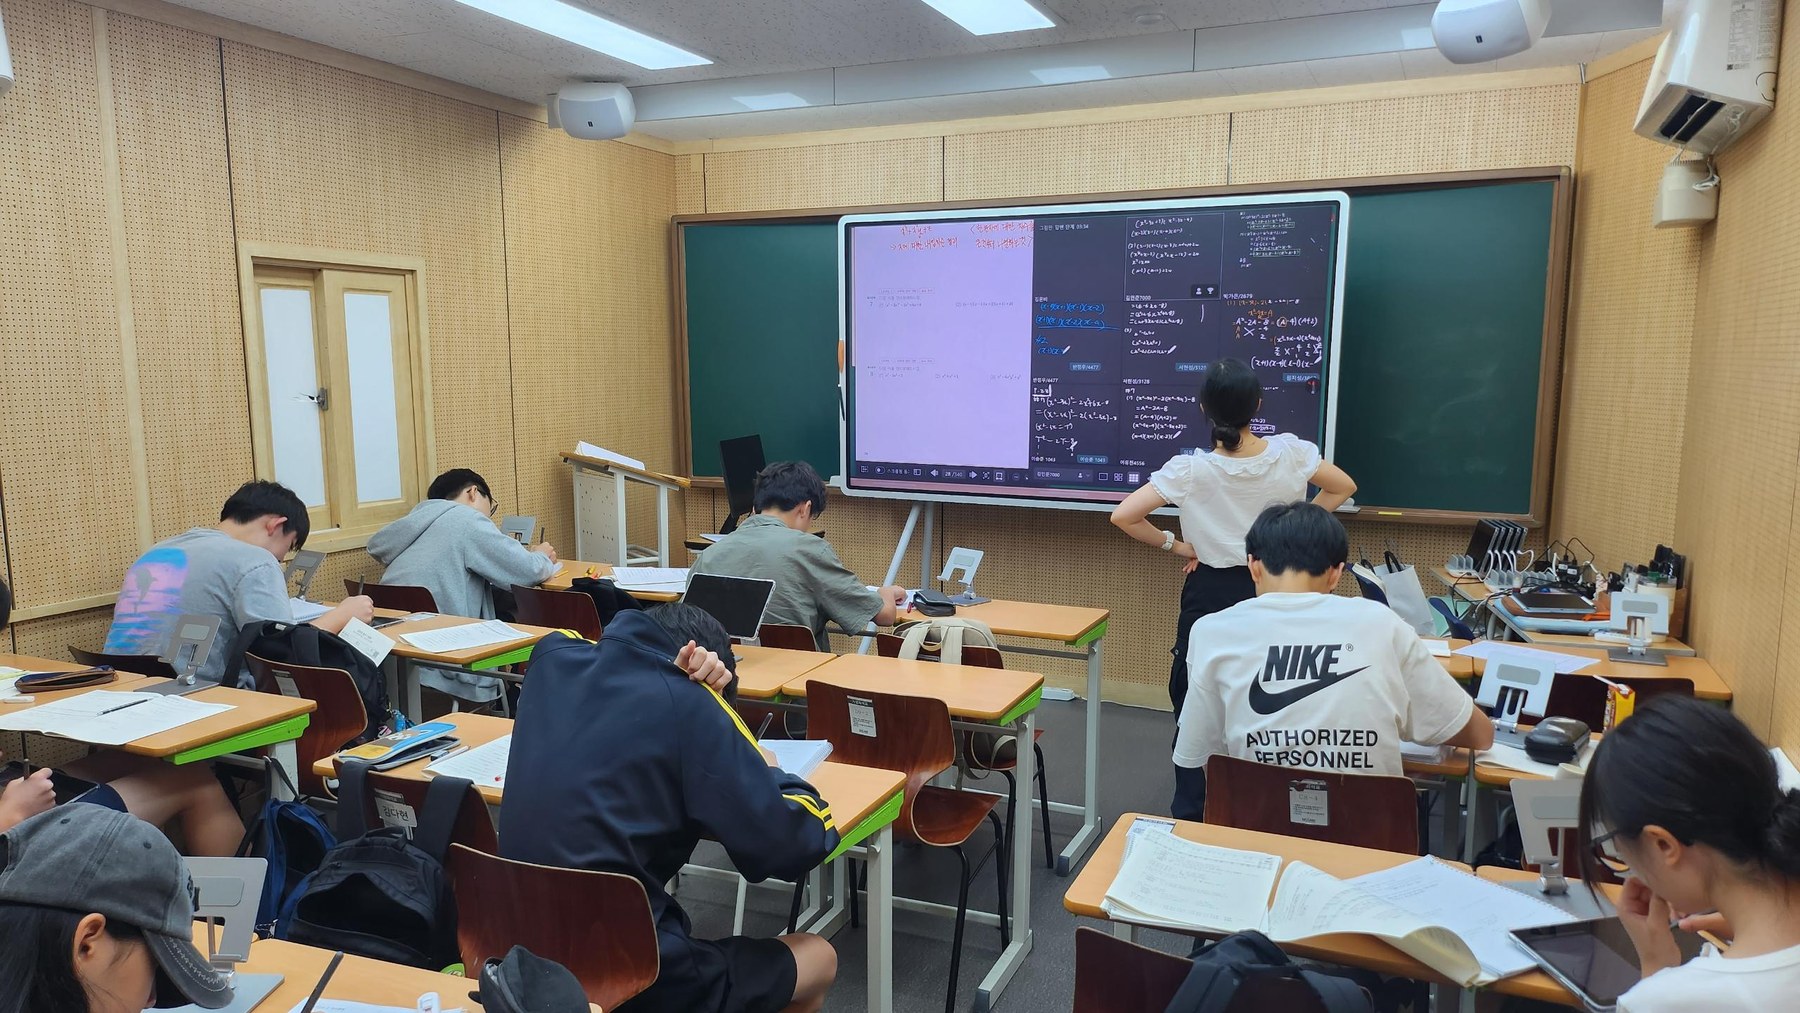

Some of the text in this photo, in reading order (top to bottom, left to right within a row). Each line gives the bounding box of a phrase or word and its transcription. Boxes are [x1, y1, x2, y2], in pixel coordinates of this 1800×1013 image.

[1262, 644, 1342, 682] NIKE
[1246, 729, 1378, 748] AUTHORIZED
[383, 805, 409, 822] 김다현
